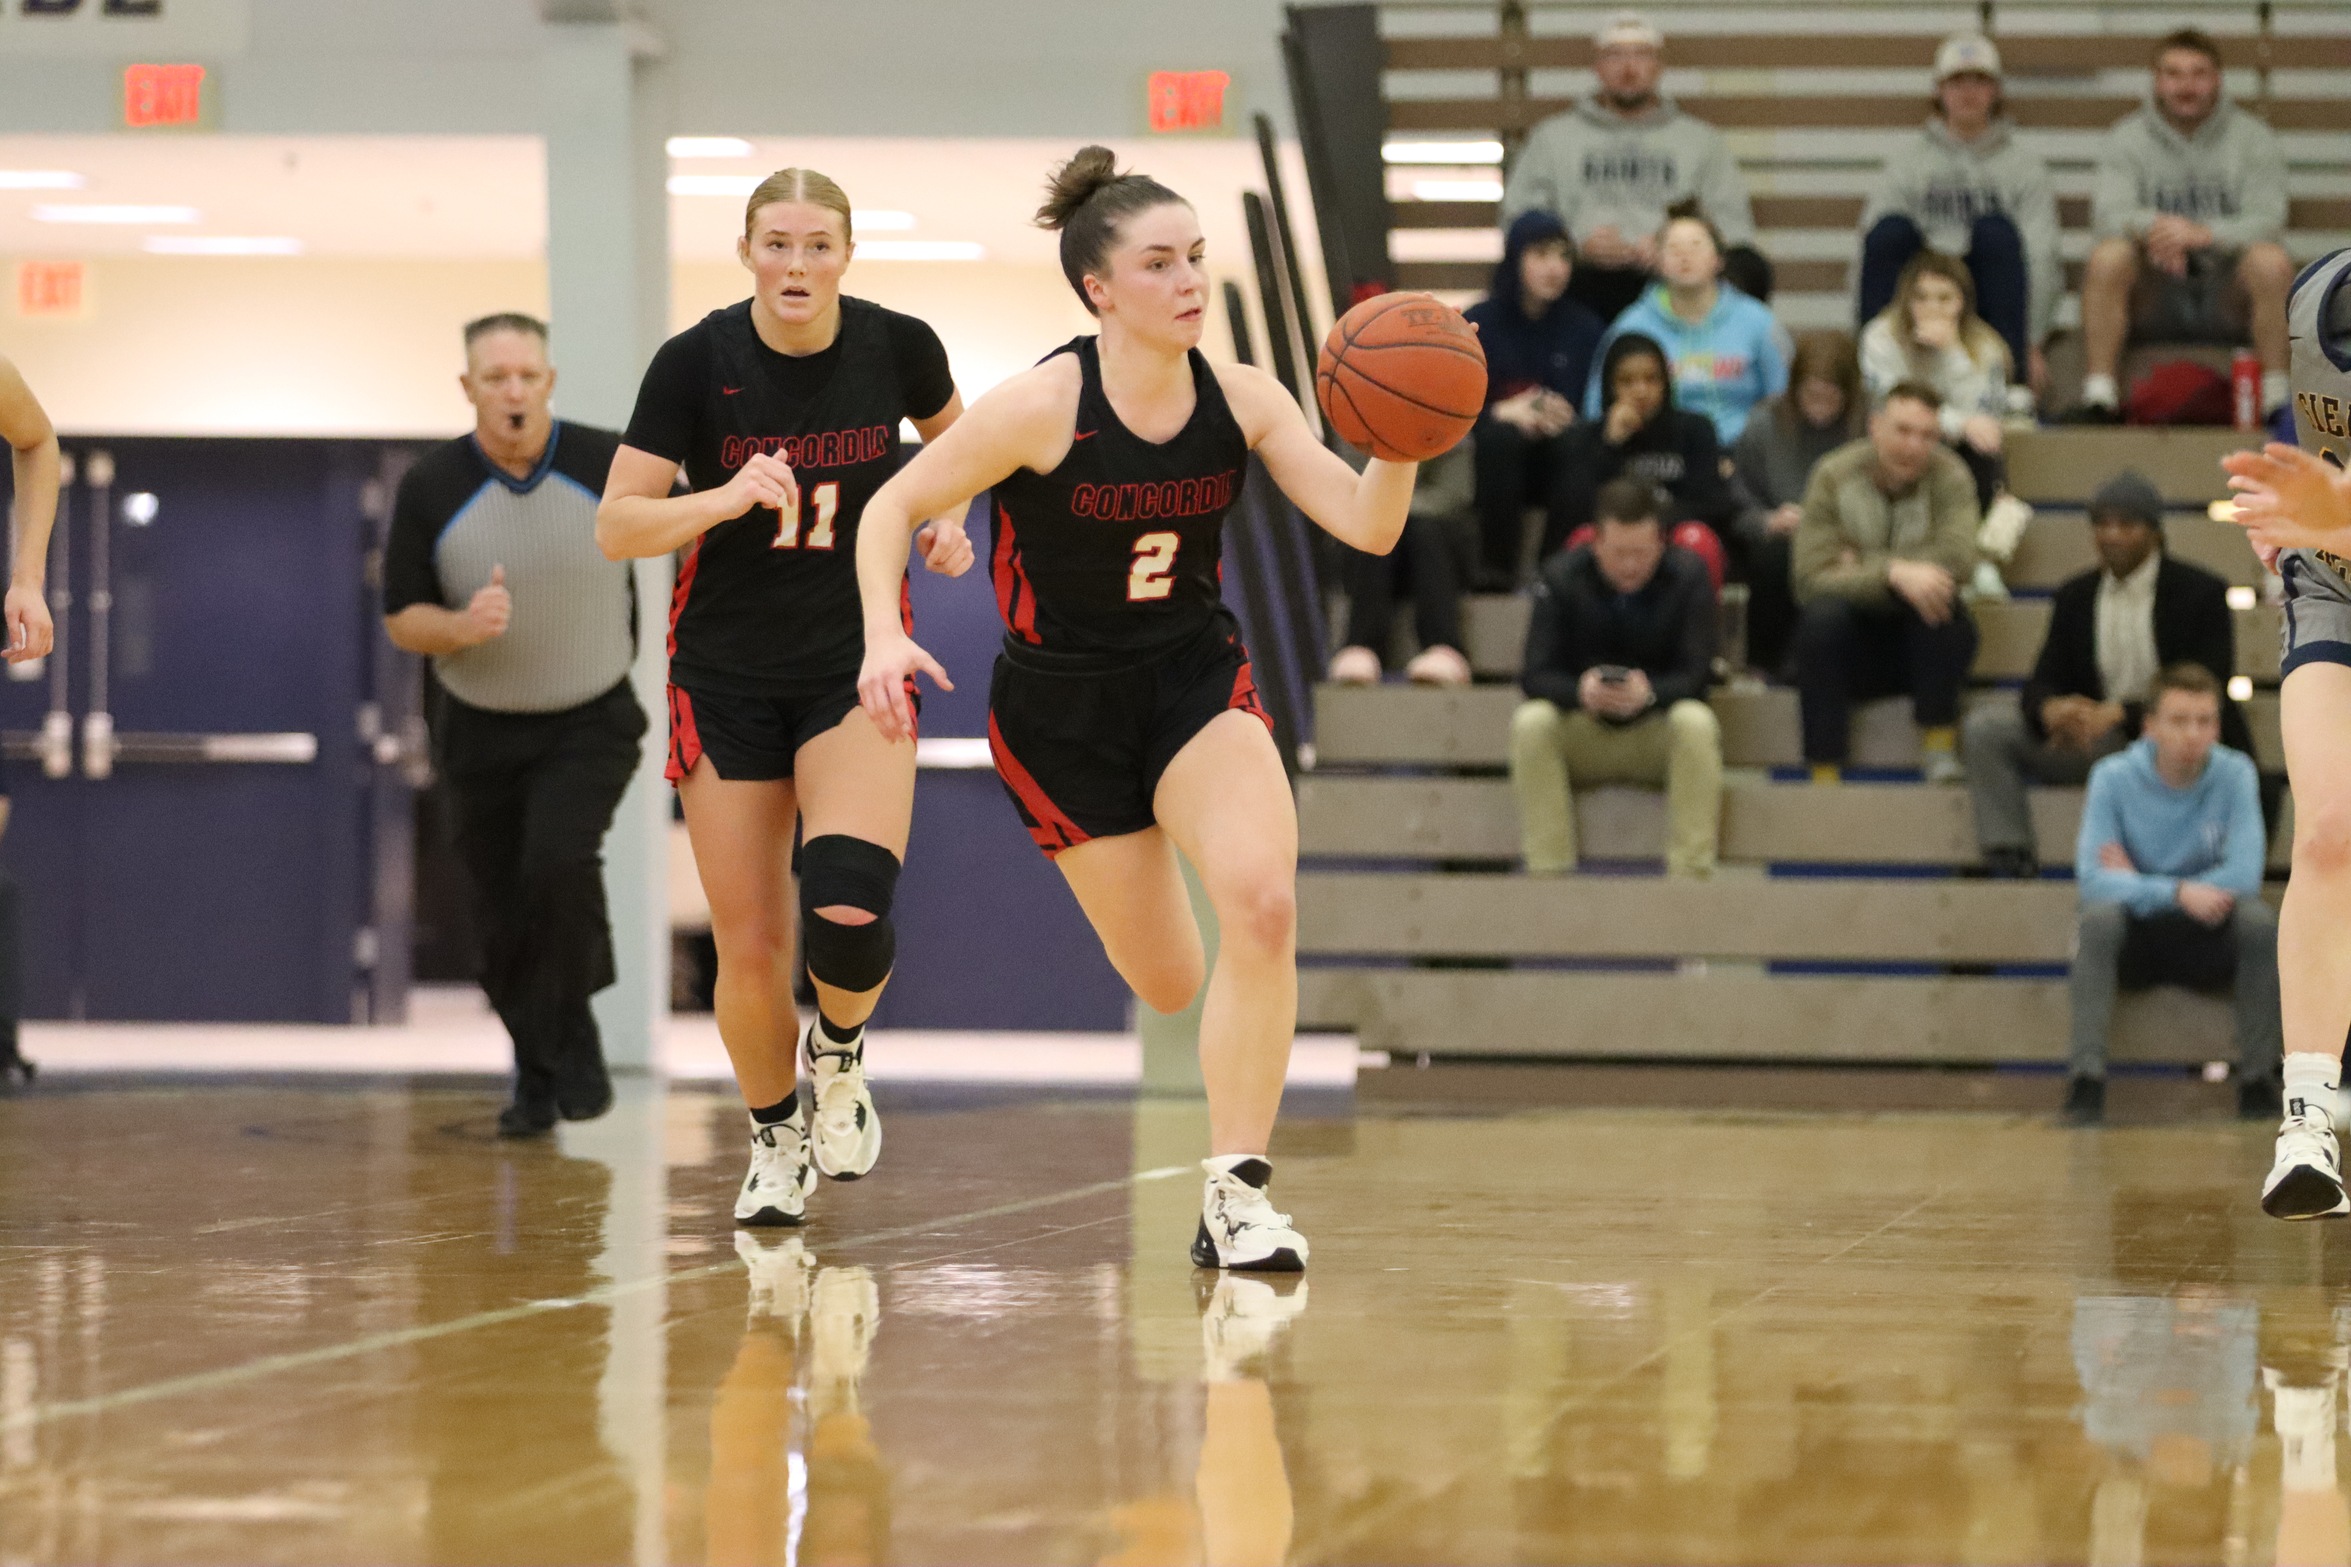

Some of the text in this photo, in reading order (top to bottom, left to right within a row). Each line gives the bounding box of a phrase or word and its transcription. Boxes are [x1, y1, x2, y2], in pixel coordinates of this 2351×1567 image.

[124, 64, 206, 127] EXIT
[1147, 70, 1231, 133] EXIT
[770, 481, 840, 550] 11
[1126, 530, 1182, 602] 2
